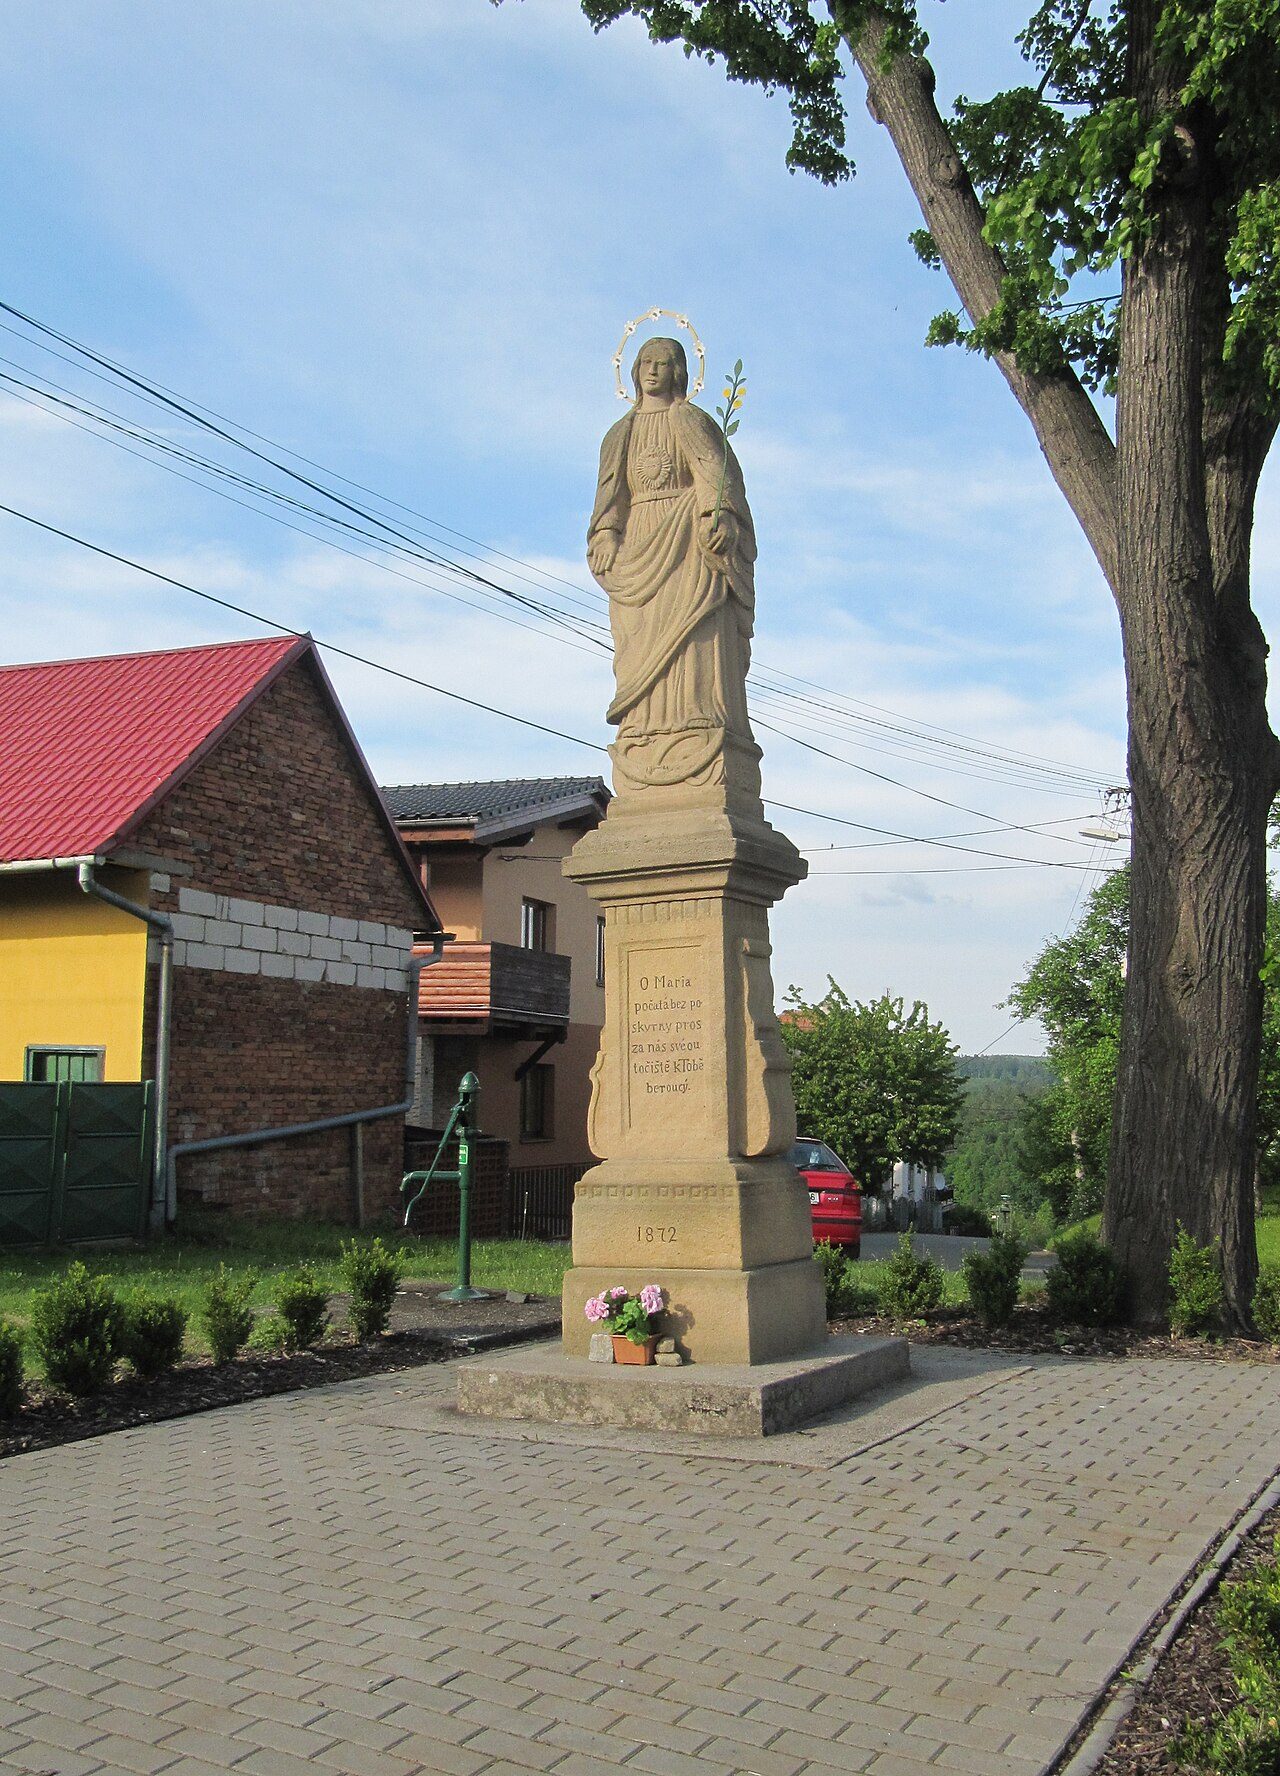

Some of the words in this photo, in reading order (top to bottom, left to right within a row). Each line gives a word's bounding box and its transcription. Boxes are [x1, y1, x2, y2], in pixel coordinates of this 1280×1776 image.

[640, 976, 649, 991] O
[654, 975, 692, 989] Maria
[670, 998, 687, 1010] bez
[676, 1019, 702, 1033] pros
[631, 1043, 645, 1054] za
[647, 1039, 667, 1053] nás
[637, 1226, 677, 1243] 1872
